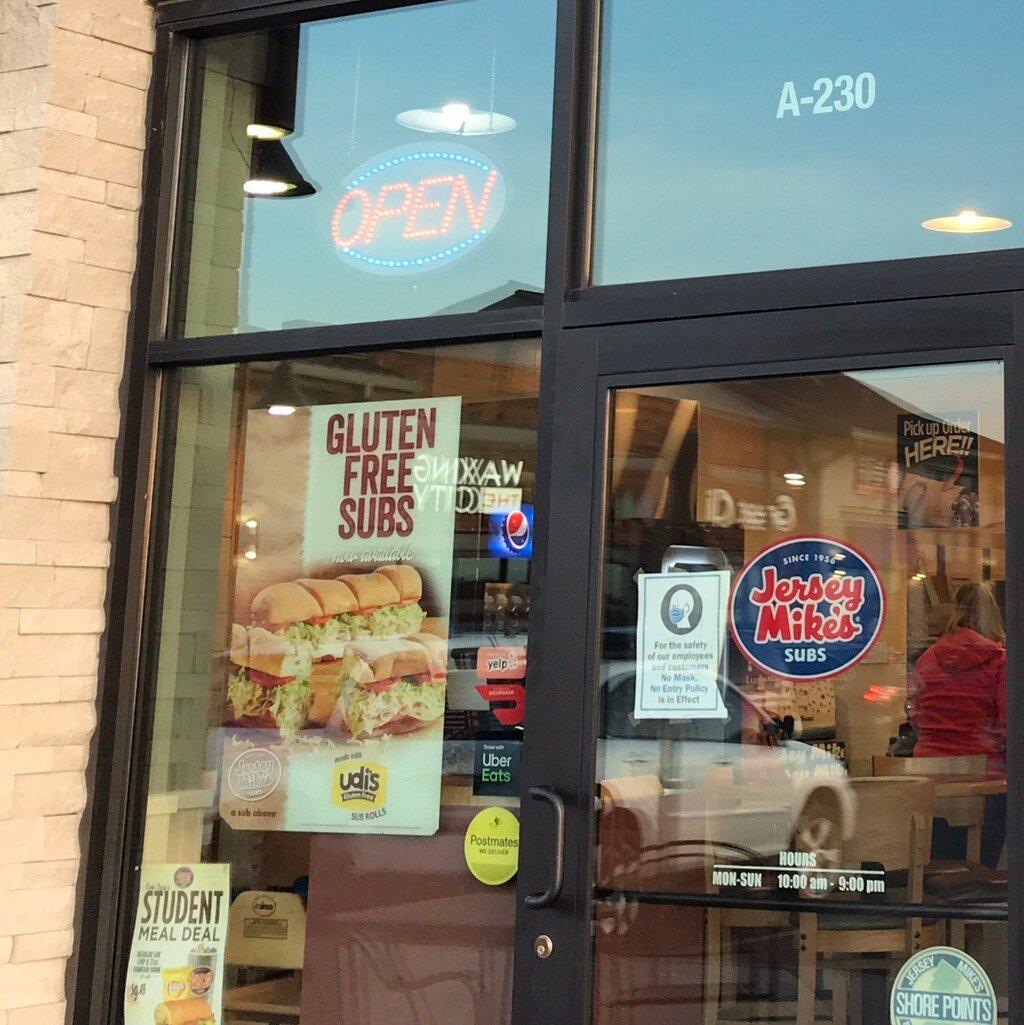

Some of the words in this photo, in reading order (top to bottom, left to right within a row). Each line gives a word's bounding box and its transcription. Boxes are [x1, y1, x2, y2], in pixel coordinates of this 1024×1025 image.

[775, 71, 877, 119] A-230
[331, 167, 498, 248] OPEN
[326, 407, 437, 455] GLUTEN
[903, 420, 924, 436] Pick
[925, 422, 940, 437] up
[942, 419, 972, 434] Order
[904, 435, 975, 468] HERE!!
[343, 452, 416, 496] FREE
[338, 494, 415, 540] SUBS
[782, 554, 810, 565] SINCE
[814, 554, 836, 565] 1956
[751, 568, 863, 612] Jersey
[755, 603, 862, 642] Mike's
[654, 641, 667, 650] For
[669, 641, 682, 650] the
[683, 641, 708, 651] safety
[647, 652, 656, 661] of
[657, 653, 670, 661] our
[672, 653, 714, 662] employees
[784, 647, 827, 663] SUBS
[487, 659, 508, 671] yelp
[651, 663, 666, 671] and
[661, 674, 671, 682] No
[650, 684, 661, 693] No
[662, 684, 683, 694] Entry
[685, 684, 709, 694] Policy
[667, 696, 675, 704] in
[676, 696, 700, 704] Effect
[482, 752, 512, 768] Uber
[339, 766, 381, 792] udi's
[481, 768, 511, 783] Eats
[365, 806, 387, 821] ROLLS
[470, 834, 520, 848] Postmates
[779, 851, 817, 868] HOURS
[712, 871, 763, 888] MON-SUN
[777, 874, 808, 890] 10:00
[809, 877, 828, 891] am
[838, 876, 865, 892] 9:00
[866, 878, 886, 894] pm
[140, 890, 224, 925] STUDENT
[138, 926, 177, 942] MEAL
[181, 926, 220, 942] DEAL
[906, 955, 935, 986] JERSEY
[956, 960, 985, 994] MIKE'S
[895, 991, 940, 1018] SHORE
[942, 994, 992, 1022] POINTS
